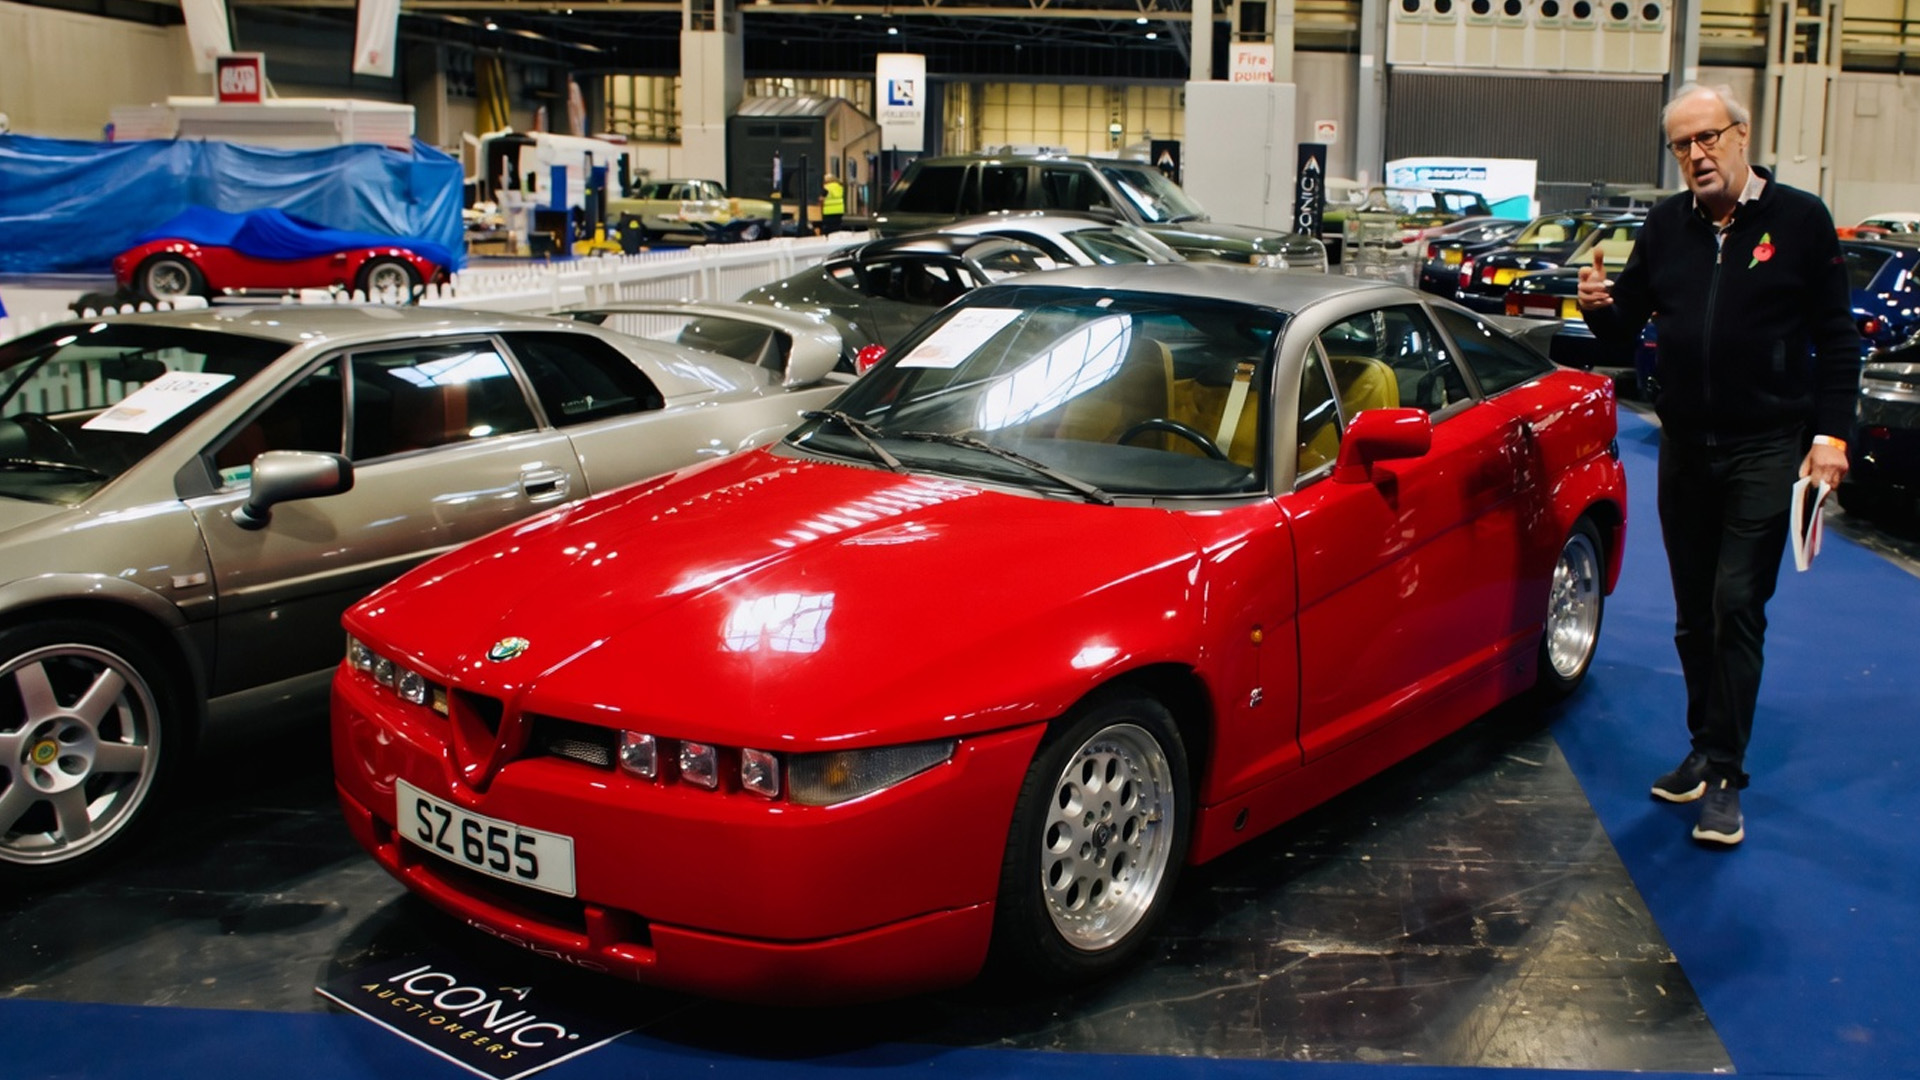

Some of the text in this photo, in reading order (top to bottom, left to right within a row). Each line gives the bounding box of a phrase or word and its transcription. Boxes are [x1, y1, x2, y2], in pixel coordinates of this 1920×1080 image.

[1238, 52, 1267, 65] Fire
[1298, 176, 1315, 236] CONIC
[416, 798, 539, 881] SZ 655
[361, 982, 519, 1060] AUCTIONEERS
[388, 964, 567, 1049] ICONIC
